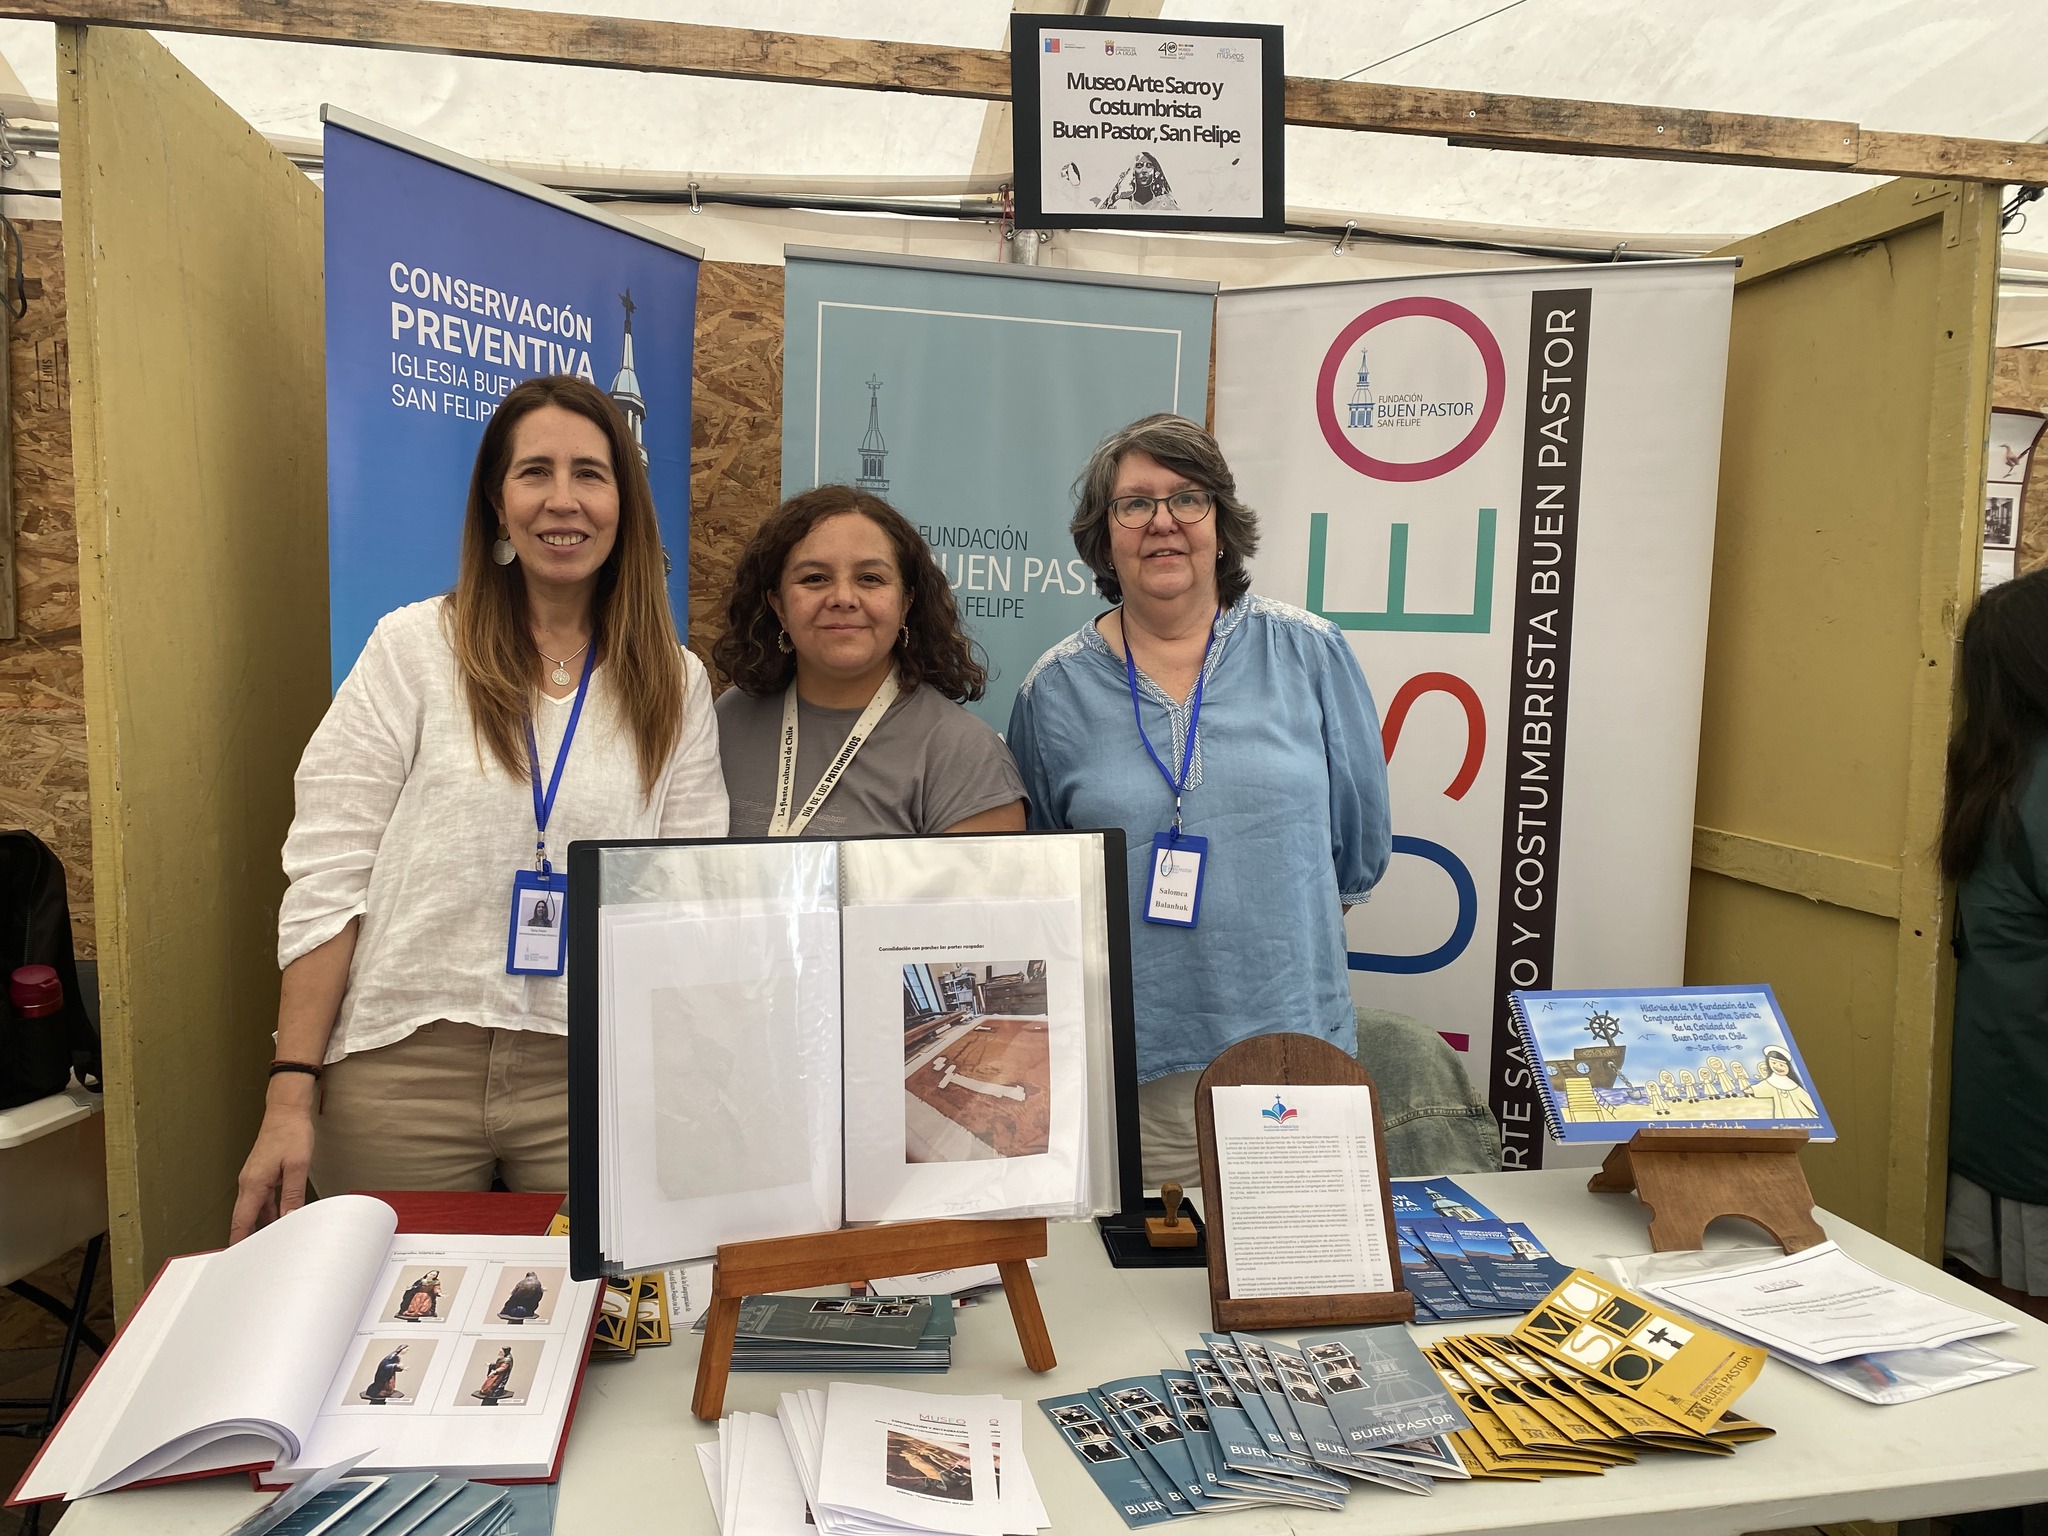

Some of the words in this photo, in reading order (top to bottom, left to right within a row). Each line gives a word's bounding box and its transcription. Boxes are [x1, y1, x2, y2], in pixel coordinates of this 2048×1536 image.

[1067, 72, 1126, 92] Museo
[1127, 75, 1164, 92] Arte
[1166, 76, 1210, 96] Sacro
[1212, 82, 1224, 100] y
[1089, 98, 1202, 118] Costumbrista
[1052, 120, 1098, 140] Buen
[1101, 122, 1158, 144] Pastor,
[1160, 124, 1191, 142] San
[1193, 125, 1241, 148] Felipe
[390, 262, 592, 344] CONSERVACIÓN
[391, 302, 597, 386] PREVENTIVA
[392, 351, 470, 390] IGLESIA
[392, 384, 437, 412] SAN
[1378, 392, 1422, 404] FUNDACIÓN
[1537, 308, 1577, 468] PASTOR
[1378, 403, 1416, 418] BUEN
[1420, 402, 1474, 417] PASTOR
[1378, 419, 1394, 428] SAN
[1396, 418, 1421, 428] FELIPE
[1530, 484, 1566, 595] BUEN
[931, 552, 1012, 592] UEN
[966, 596, 1024, 619] FELIPE
[786, 726, 794, 746] Chile
[786, 746, 792, 756] de
[1514, 608, 1559, 912] COSTUMBRISTA
[783, 755, 792, 785] cultural
[802, 805, 814, 818] DÍA
[810, 794, 822, 806] DE
[816, 784, 830, 799] LOS
[825, 735, 862, 783] PATRIMONIOS
[780, 786, 789, 806] fiesta
[778, 807, 786, 818] La
[1512, 922, 1541, 947] Y
[1640, 1003, 1668, 1012] Historia
[1670, 1004, 1679, 1012] de
[1679, 1003, 1688, 1011] la
[1699, 1002, 1736, 1012] Fundación
[1746, 1001, 1756, 1009] la
[1642, 1013, 1693, 1024] Congregación
[1694, 1013, 1703, 1021] de
[1704, 1012, 1734, 1020] Nuestra
[1734, 1012, 1761, 1020] Señora
[1504, 958, 1539, 1089] SAO
[1674, 1024, 1684, 1032] de
[1694, 1023, 1724, 1031] Caridad
[1726, 1022, 1737, 1030] del
[1672, 1033, 1693, 1042] Buen
[1694, 1033, 1719, 1042] Pastor
[1729, 1032, 1748, 1040] Chile
[1711, 1044, 1730, 1053] Felipe
[1501, 1100, 1531, 1169] RTE
[1754, 1279, 1799, 1292] MUSEO
[1701, 1383, 1726, 1404] BUEN
[1721, 1355, 1753, 1384] PASTOR
[920, 1413, 966, 1426] MUSEO
[1349, 1420, 1396, 1433] FUNDACIÓN
[1350, 1426, 1397, 1442] BUEN
[1398, 1414, 1456, 1432] PASTOR
